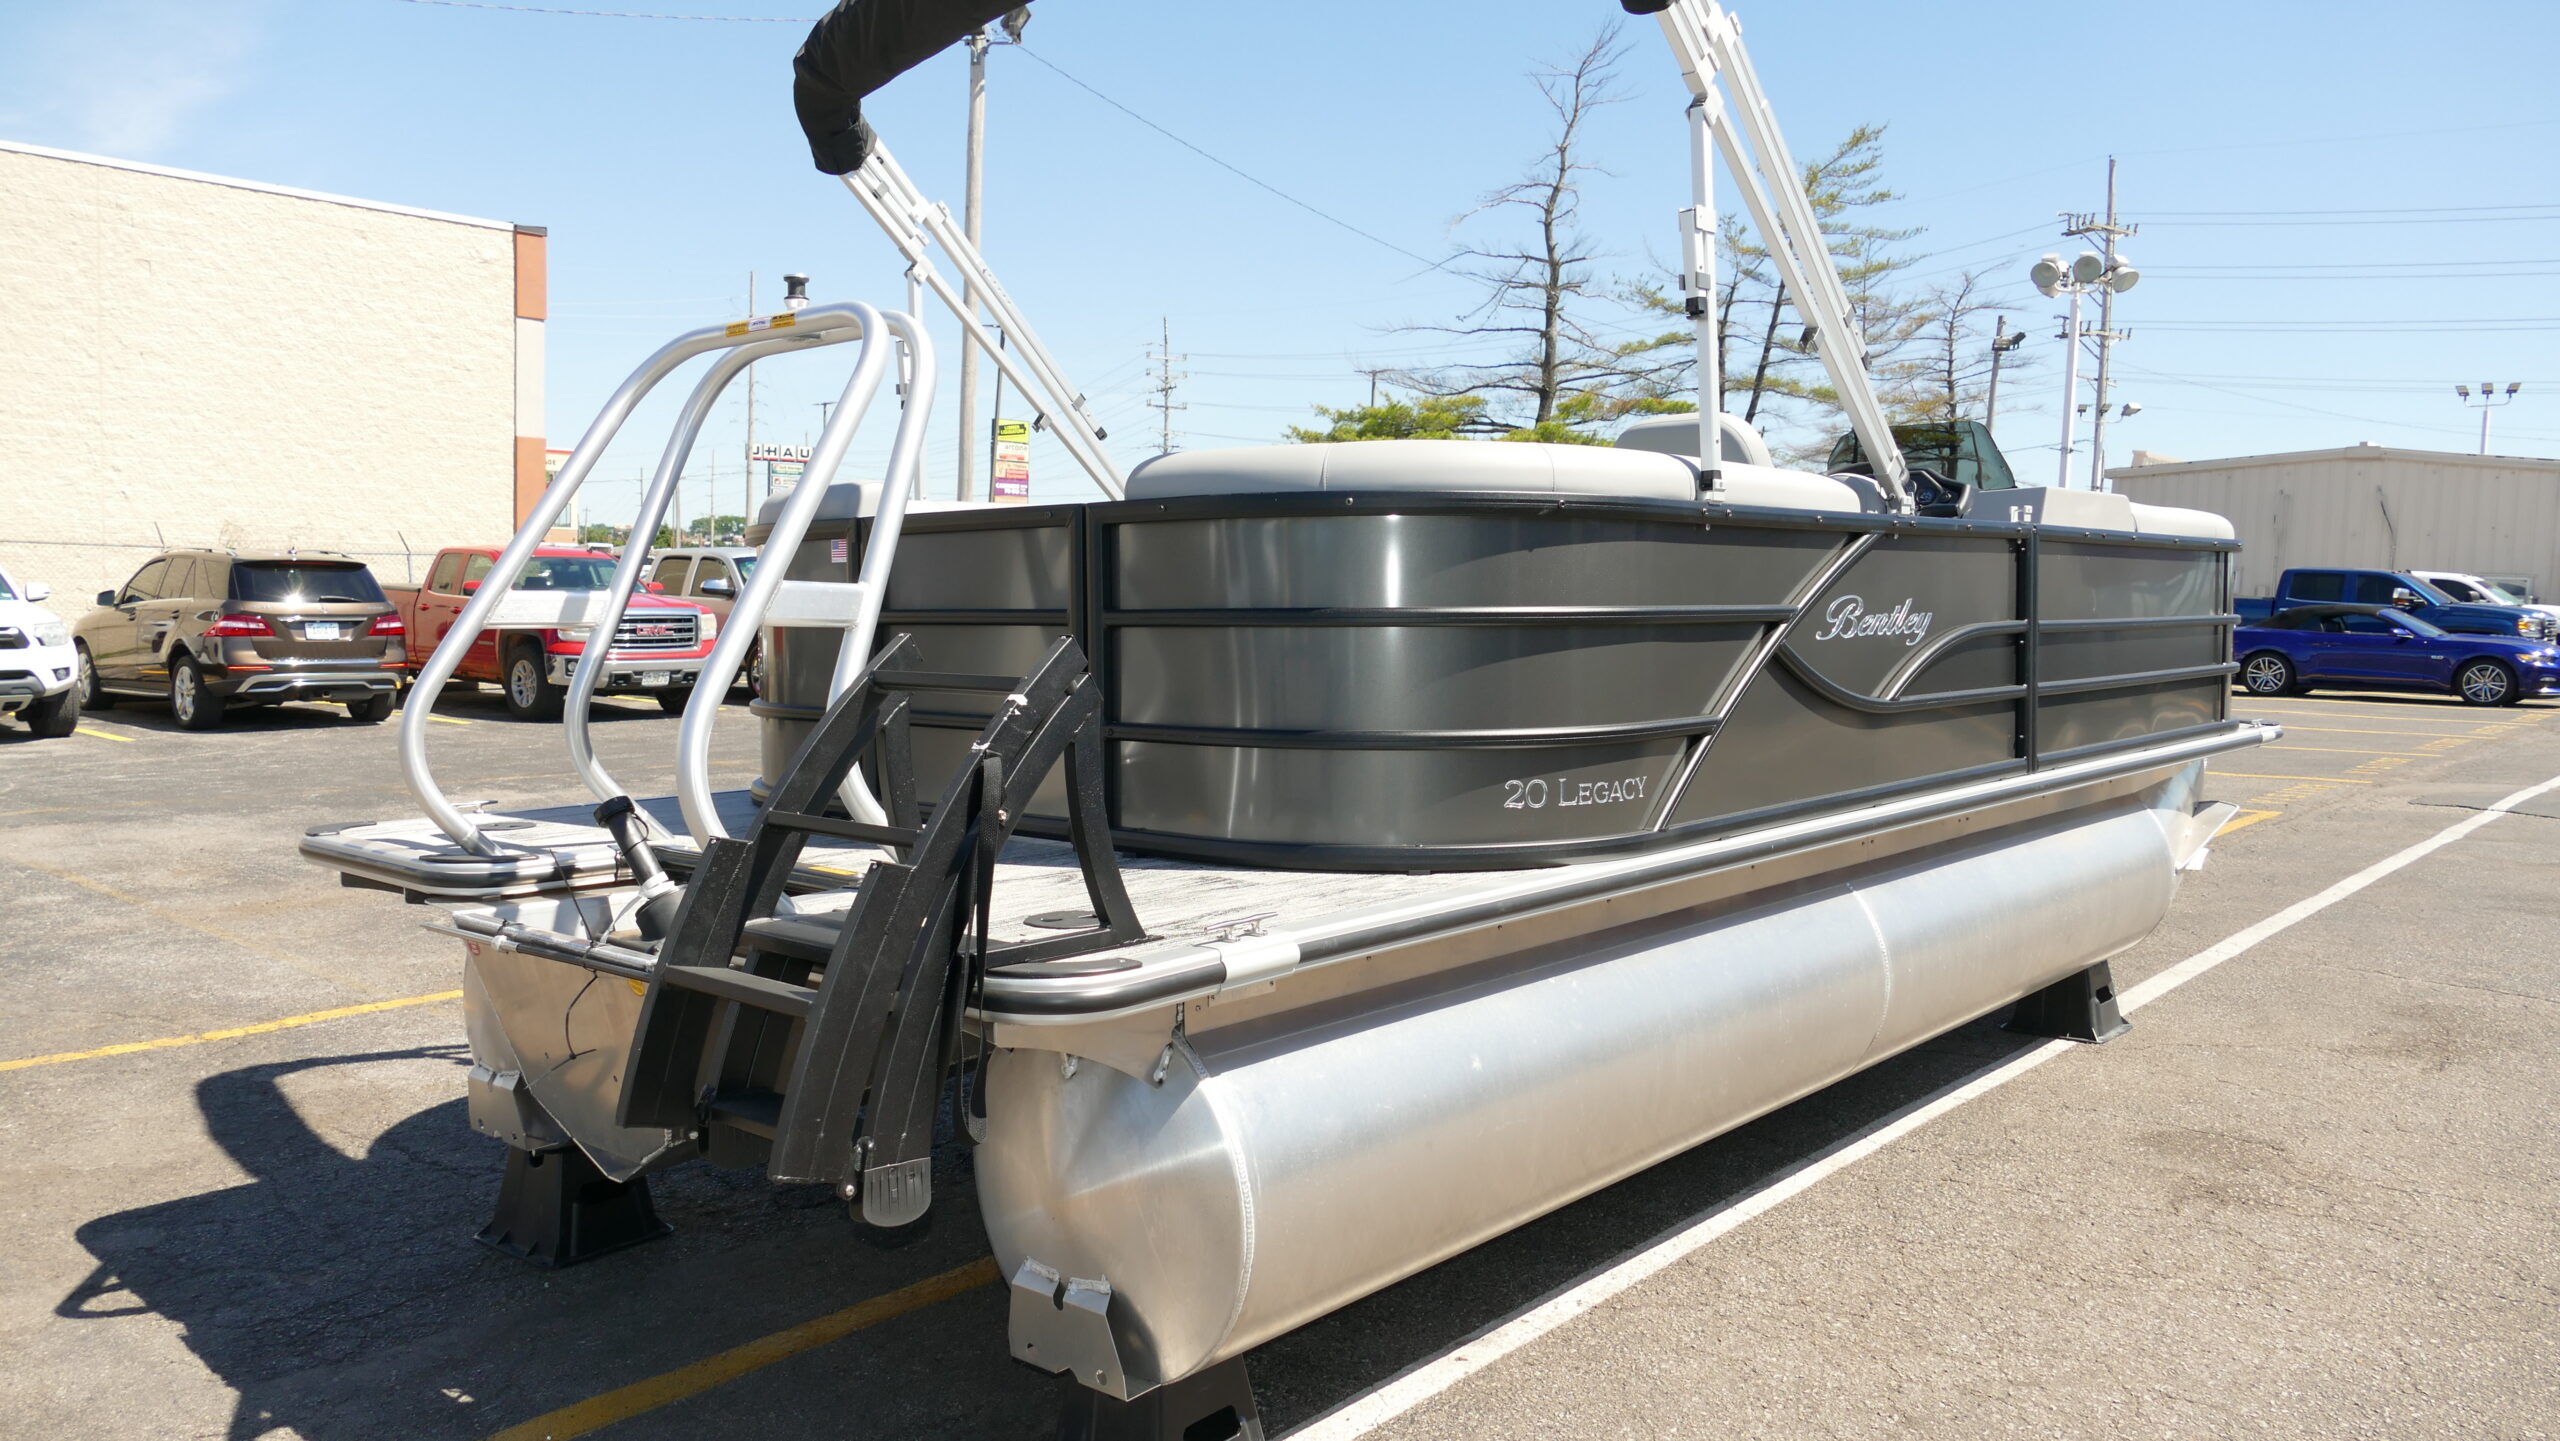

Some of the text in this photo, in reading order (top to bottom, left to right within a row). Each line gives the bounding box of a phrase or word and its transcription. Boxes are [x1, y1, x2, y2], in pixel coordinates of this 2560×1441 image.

[637, 626, 674, 636] GMC
[1815, 595, 1933, 646] Bentley
[1504, 776, 1648, 809] 20 LEGACY
